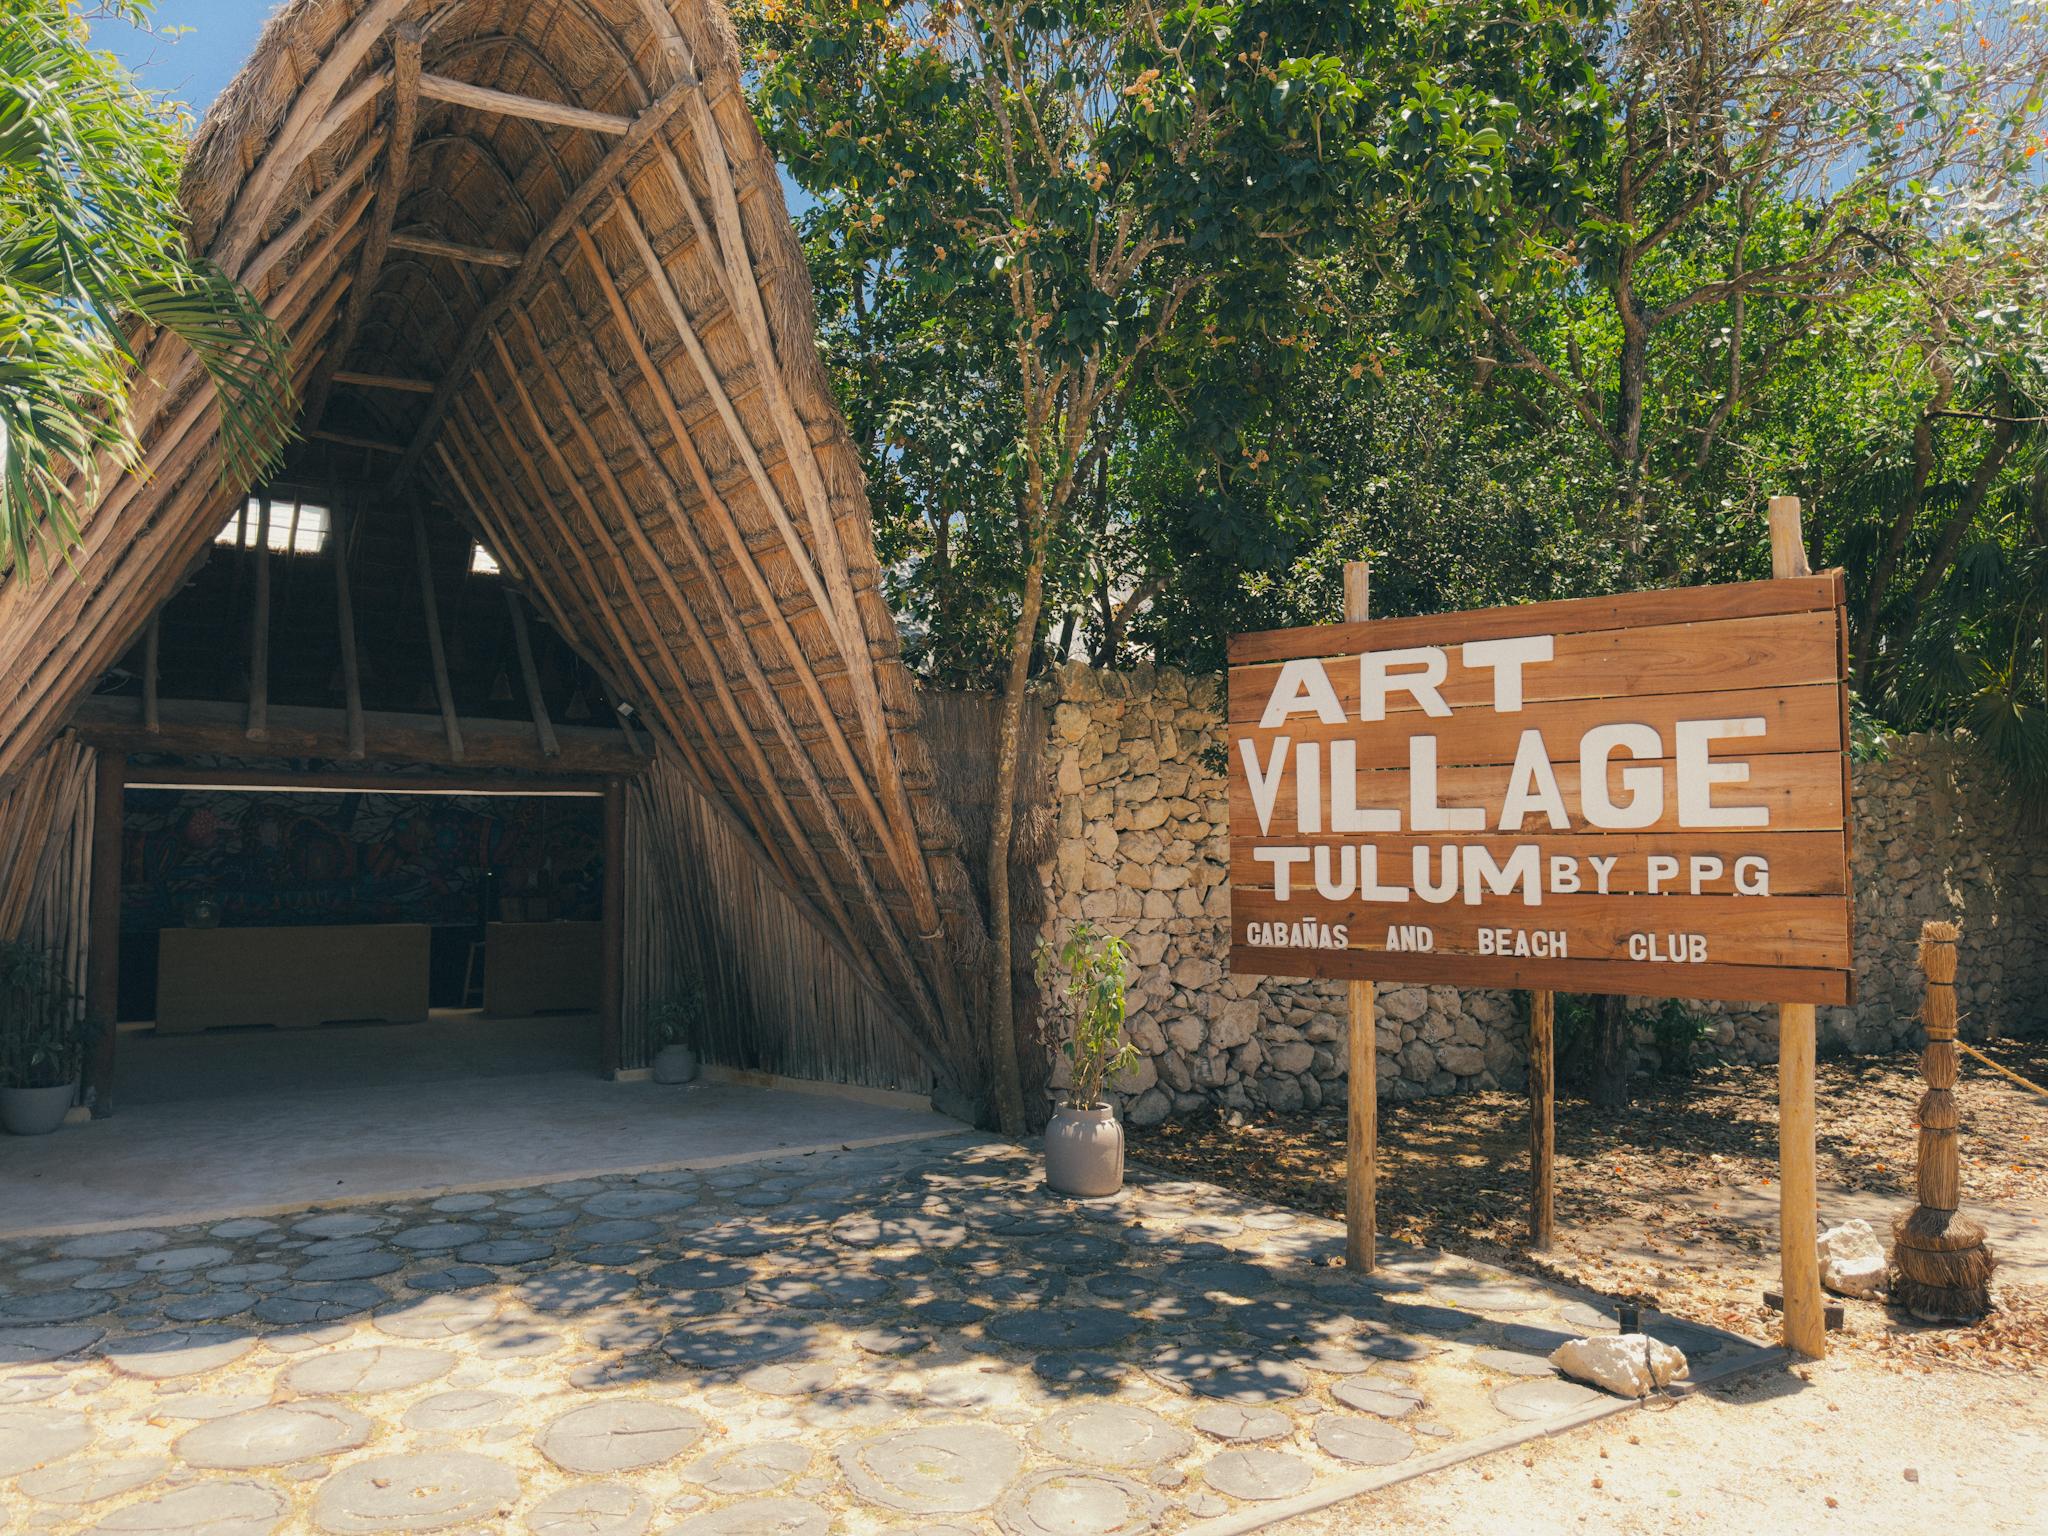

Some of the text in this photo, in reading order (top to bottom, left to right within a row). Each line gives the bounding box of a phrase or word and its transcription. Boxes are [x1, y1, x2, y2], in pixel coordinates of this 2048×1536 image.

[1258, 635, 1554, 729] ART
[1238, 716, 1770, 837] VILLAGE
[1253, 844, 1770, 906] TULUM BY PPG
[1246, 916, 1707, 963] CABAÑAS AND BEACH CLUB
